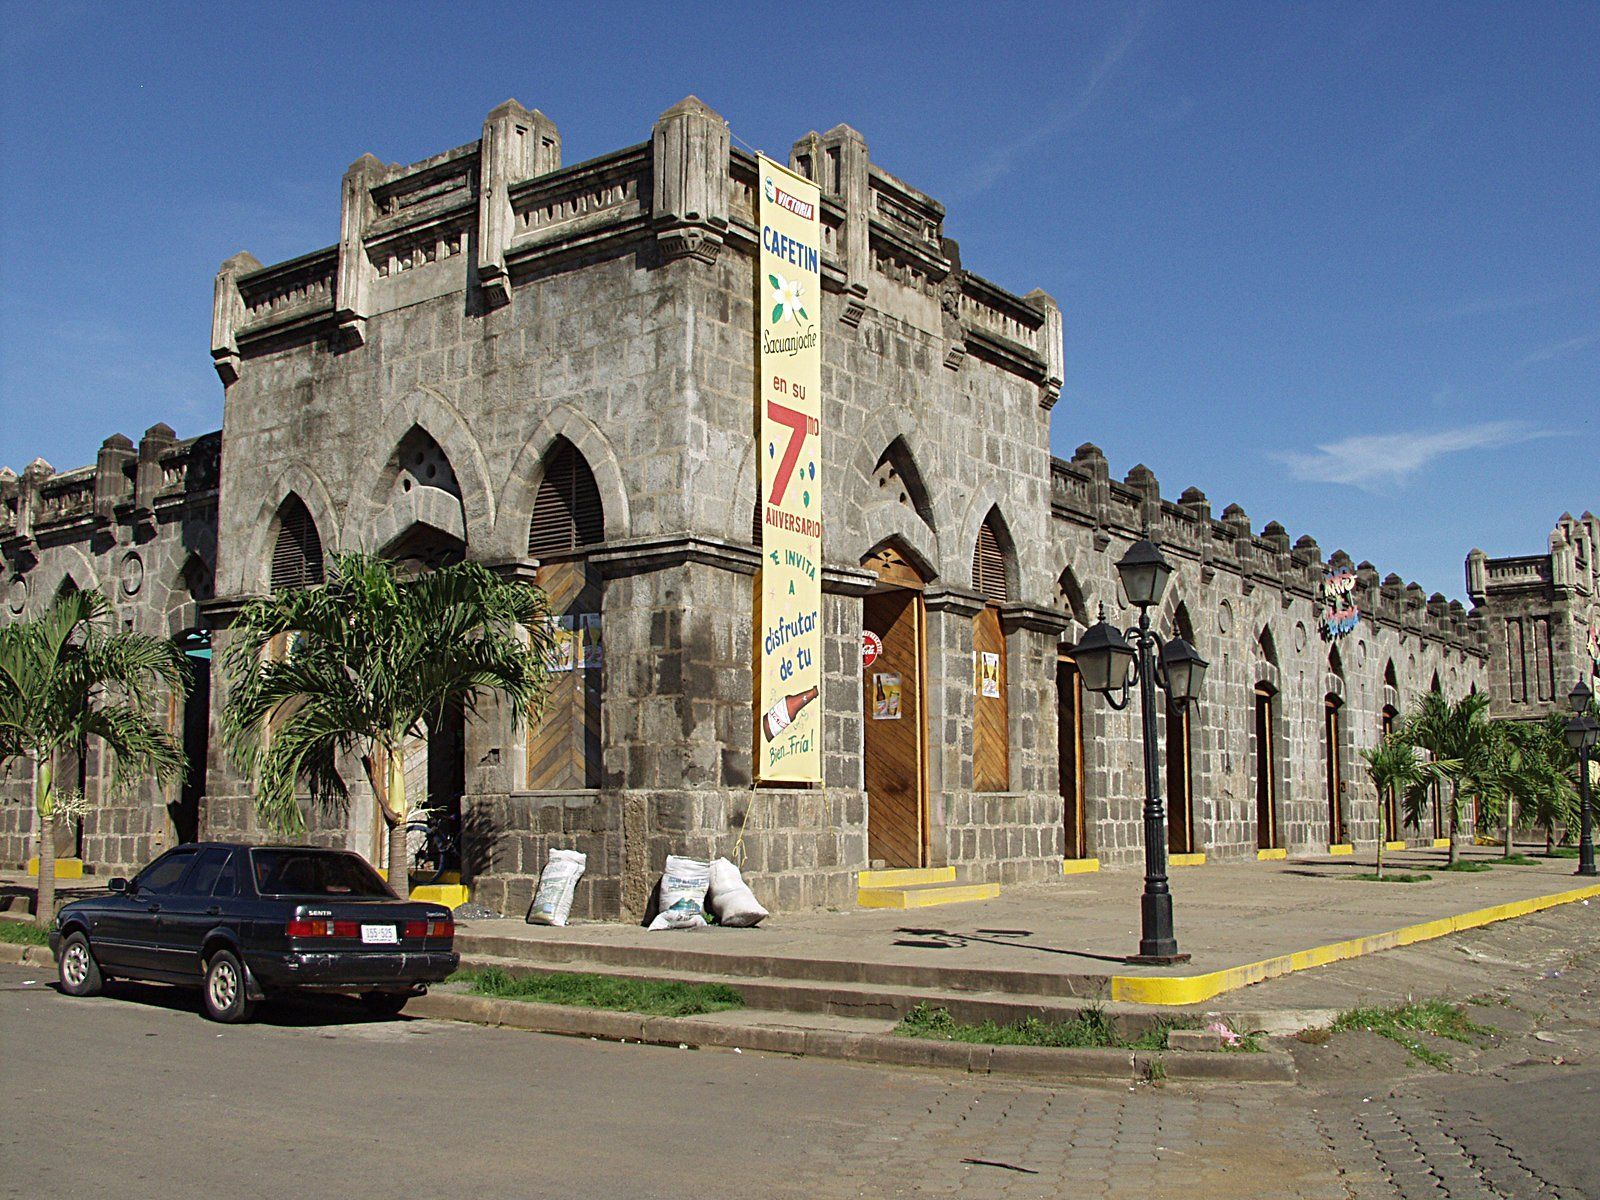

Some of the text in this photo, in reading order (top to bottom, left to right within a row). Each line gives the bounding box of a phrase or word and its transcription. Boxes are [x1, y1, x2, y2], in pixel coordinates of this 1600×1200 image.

[777, 190, 813, 219] VICTORIA
[763, 225, 818, 274] CAFETIN
[763, 324, 817, 356] Sacuanjoche
[773, 375, 806, 400] en su
[785, 549, 816, 581] INVITA
[788, 579, 796, 596] A
[765, 611, 817, 655] disfrutar
[780, 647, 811, 682] de tu
